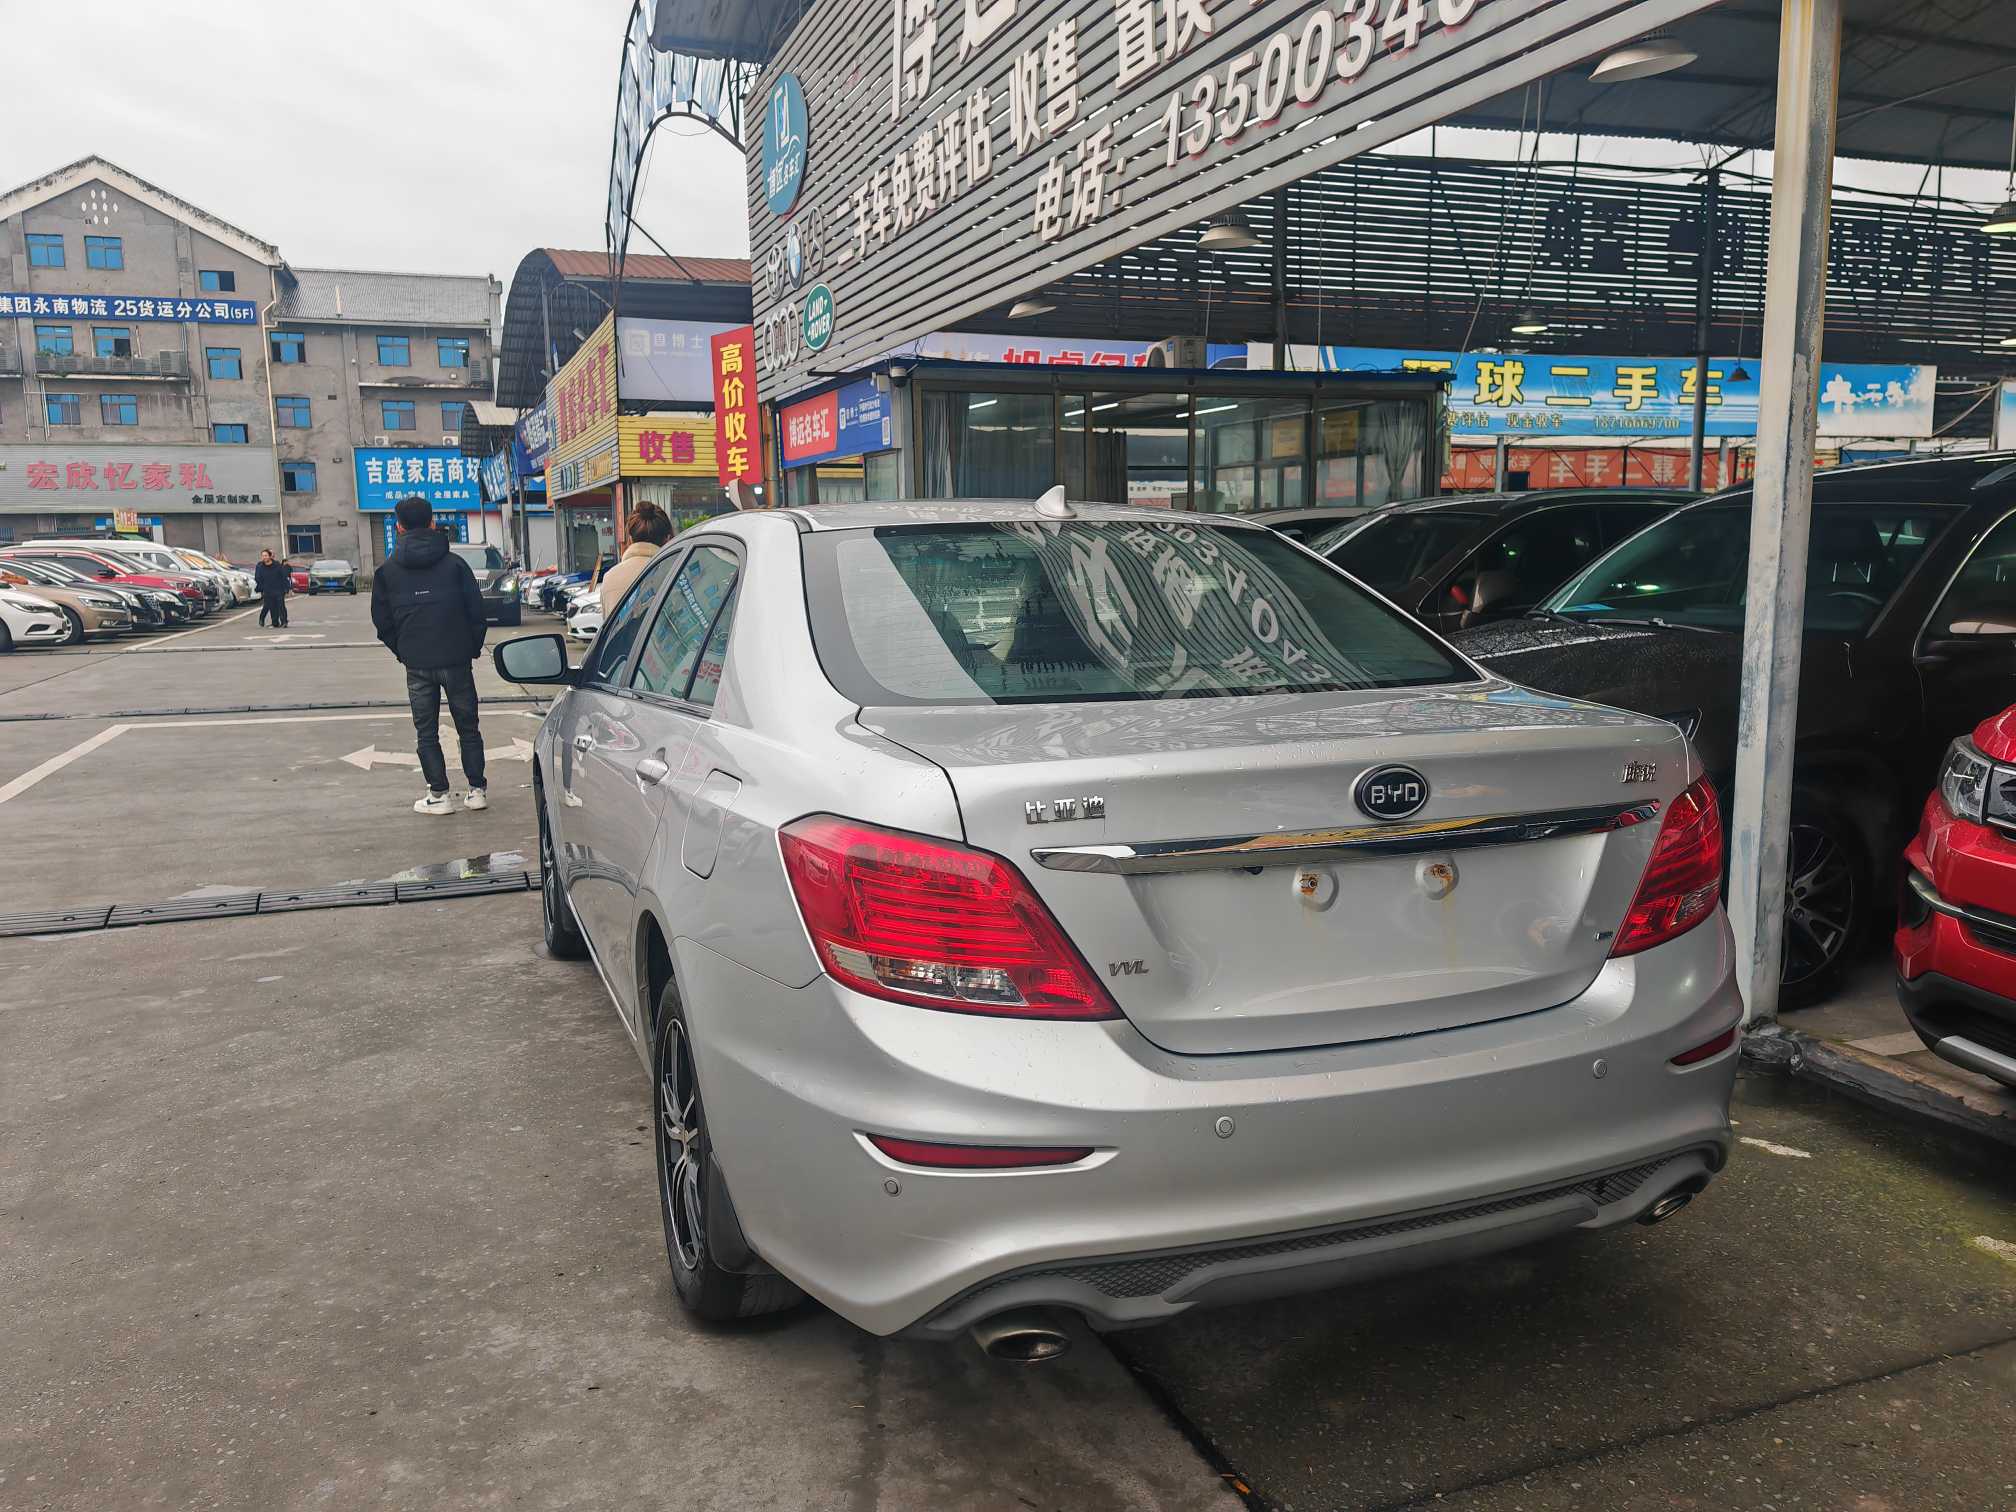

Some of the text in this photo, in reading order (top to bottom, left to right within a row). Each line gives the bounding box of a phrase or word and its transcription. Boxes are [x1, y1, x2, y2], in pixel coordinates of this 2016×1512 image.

[1160, 0, 1479, 168] 1350034
[836, 87, 993, 265] 二手车免费评估
[1009, 17, 1080, 156] 收售
[808, 296, 824, 322] LAND
[810, 312, 831, 341] ROVER
[719, 343, 750, 477] 高价收车
[639, 430, 696, 464] 收售
[26, 461, 214, 490] 宏欣忆家私
[365, 457, 480, 484] 吉盛家居商场
[1371, 783, 1419, 804] BYD
[1025, 796, 1105, 824] 比亚迪
[1109, 960, 1149, 977] VVL
